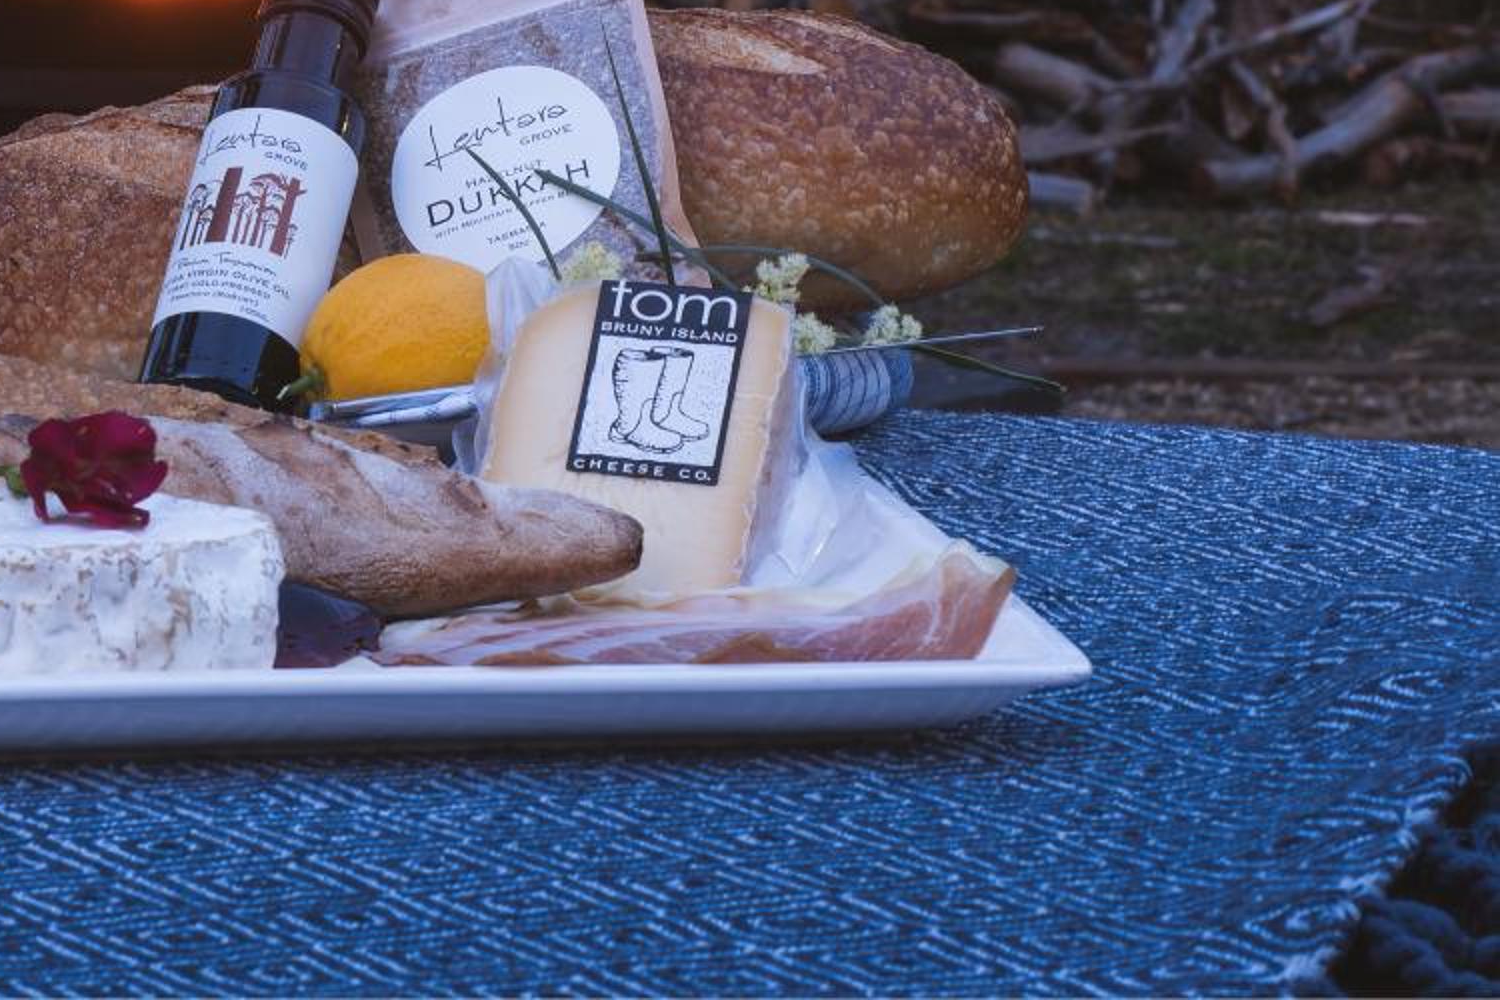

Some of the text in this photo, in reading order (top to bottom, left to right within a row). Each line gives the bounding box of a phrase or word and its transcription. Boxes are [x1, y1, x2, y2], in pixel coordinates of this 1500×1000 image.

[519, 123, 573, 147] GROVE
[264, 151, 308, 171] GROVE
[465, 159, 543, 189] HALNUT
[232, 271, 270, 289] OLIVE
[611, 278, 739, 329] tom
[600, 320, 739, 343] BRUNY ISLAND
[572, 457, 712, 481] CHEESE CO.
